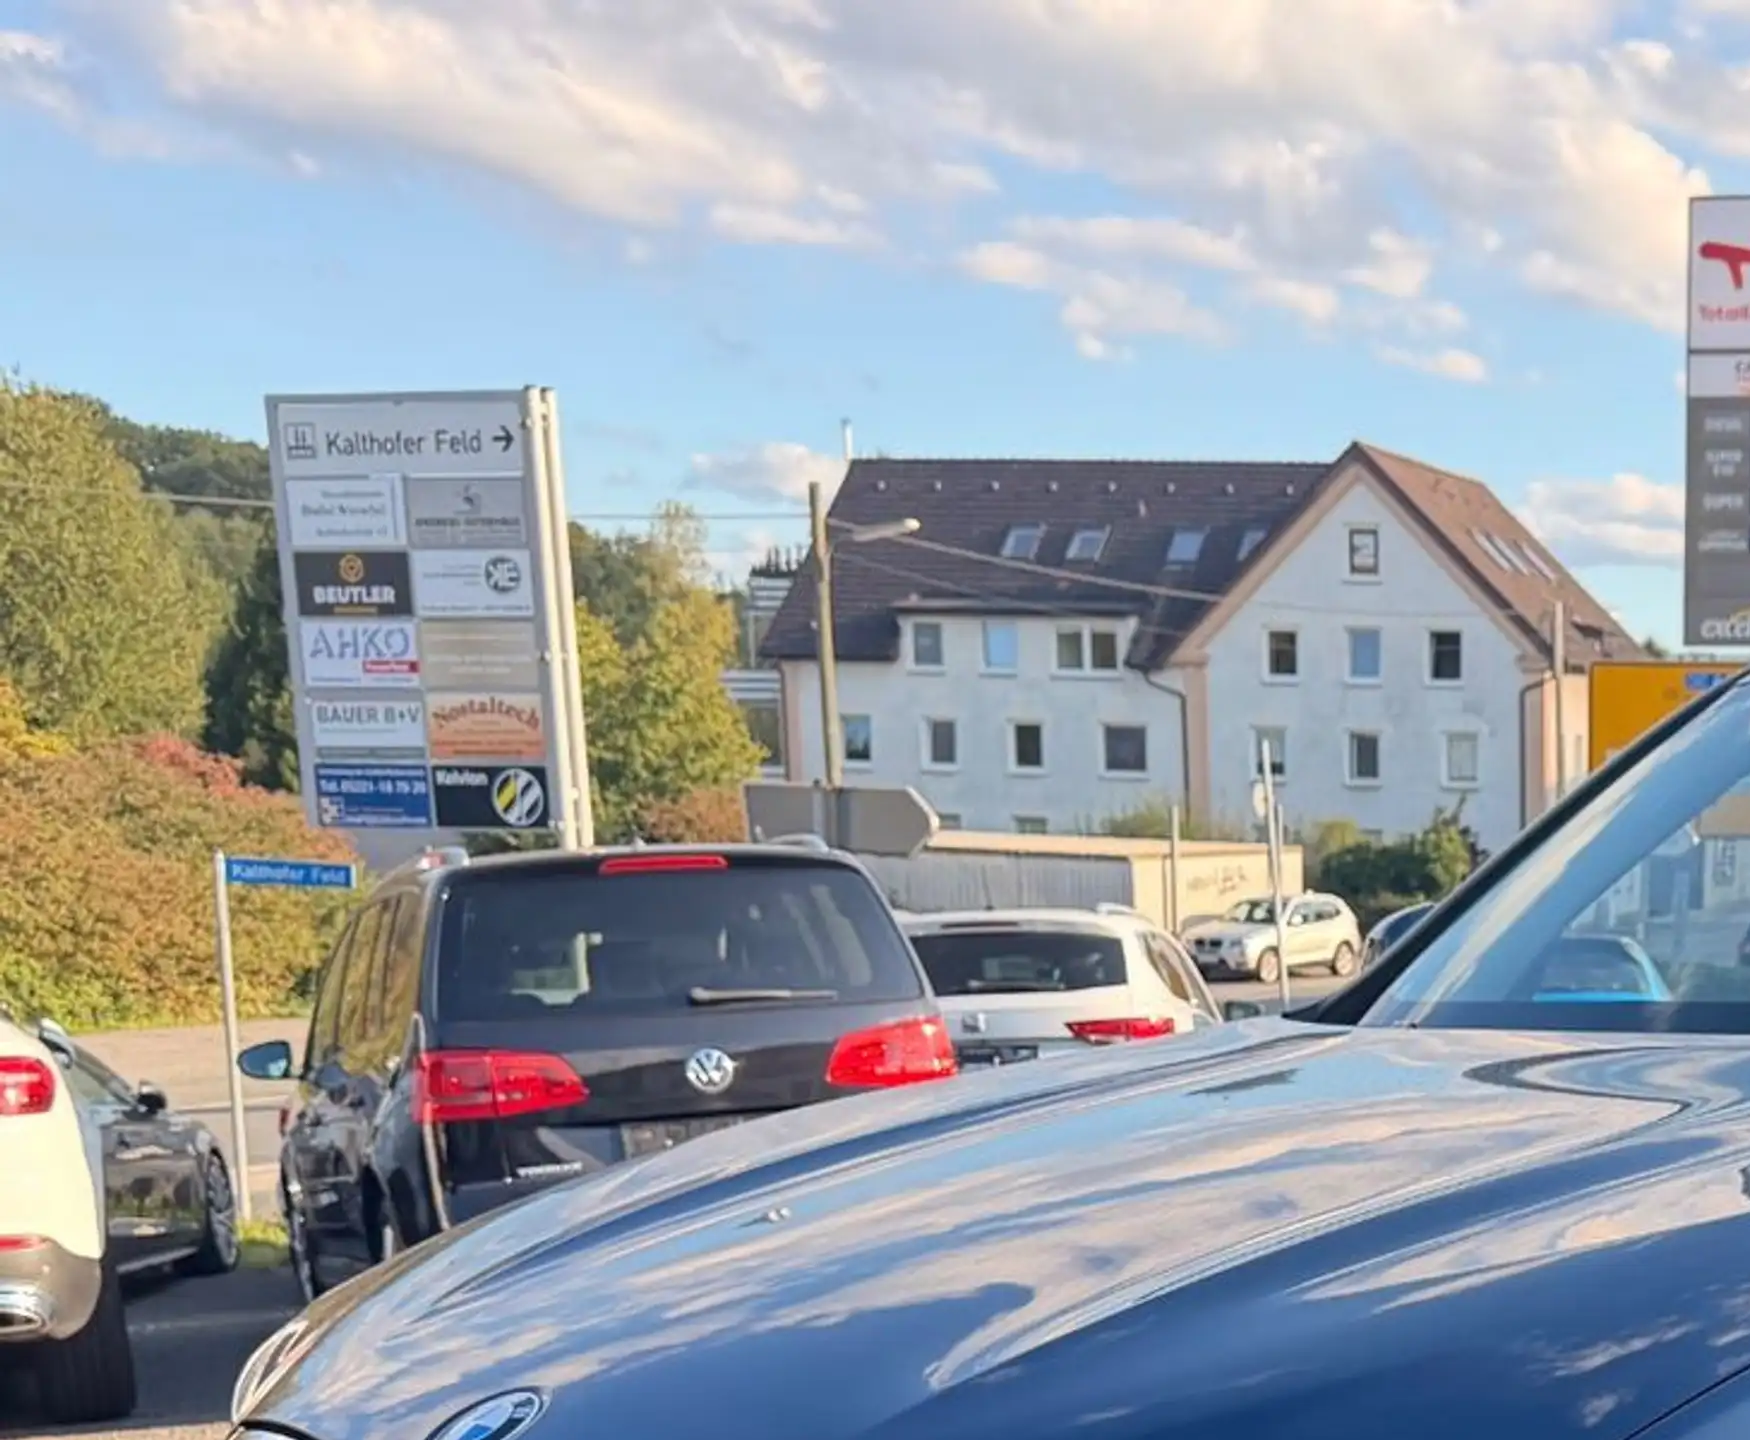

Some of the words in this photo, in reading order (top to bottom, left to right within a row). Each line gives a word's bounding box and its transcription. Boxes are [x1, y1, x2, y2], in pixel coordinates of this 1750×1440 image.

[325, 431, 425, 457] Kalthofer
[434, 429, 482, 454] Feld
[313, 585, 395, 604] BEUTLER
[309, 626, 410, 659] AHKO
[317, 705, 379, 723] BAUER
[232, 863, 304, 880] Kalthofer
[311, 866, 347, 884] Feld
